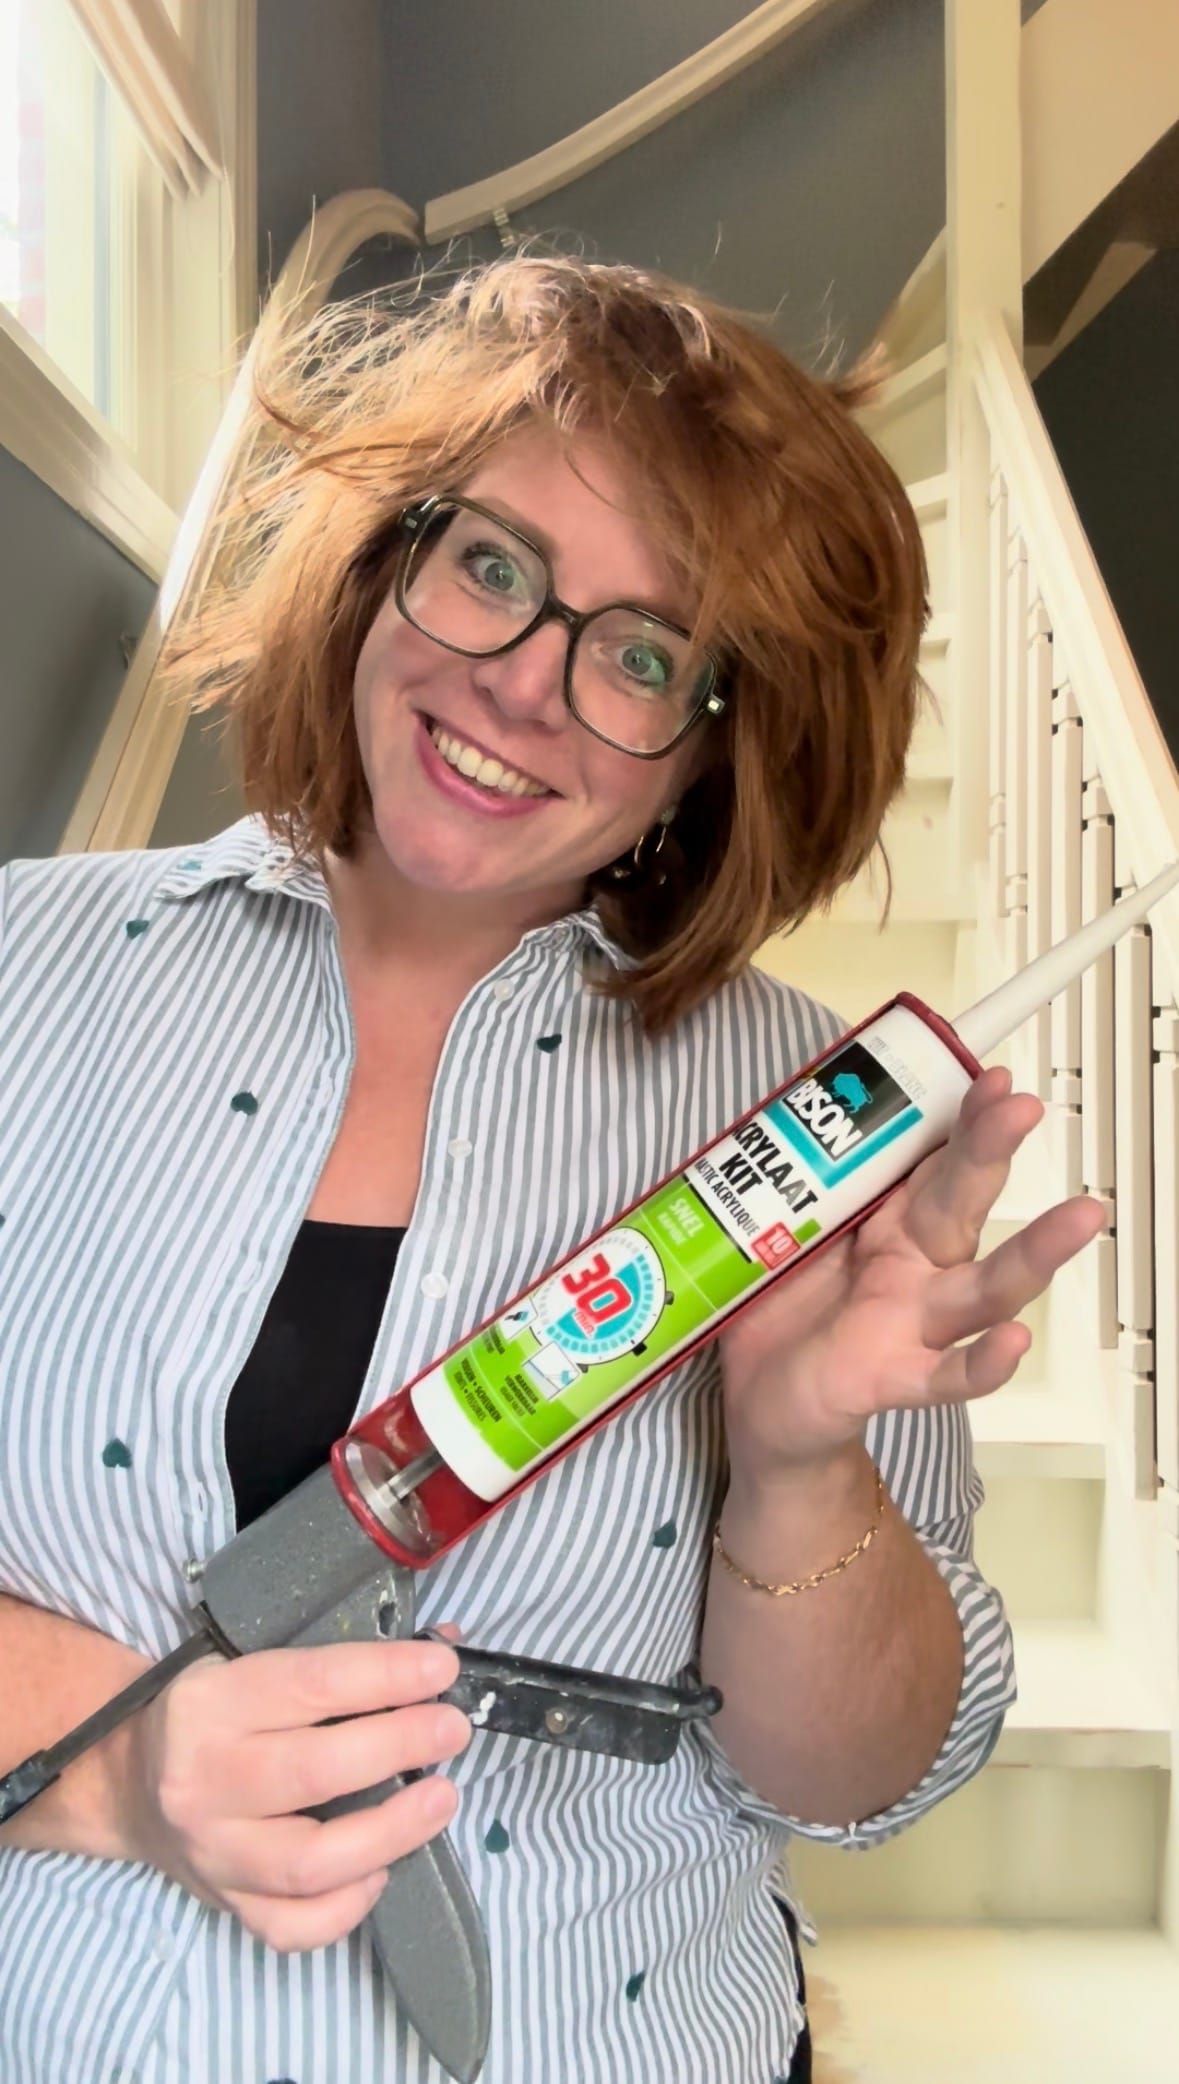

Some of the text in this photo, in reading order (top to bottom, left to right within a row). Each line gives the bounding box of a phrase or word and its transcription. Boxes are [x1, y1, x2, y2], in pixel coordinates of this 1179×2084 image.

[785, 1075, 863, 1159] BISON
[717, 1151, 763, 1198] KIT
[666, 1196, 706, 1238] SNEL
[709, 1179, 761, 1237] ACRYLIQUE
[562, 1253, 632, 1325] 30
